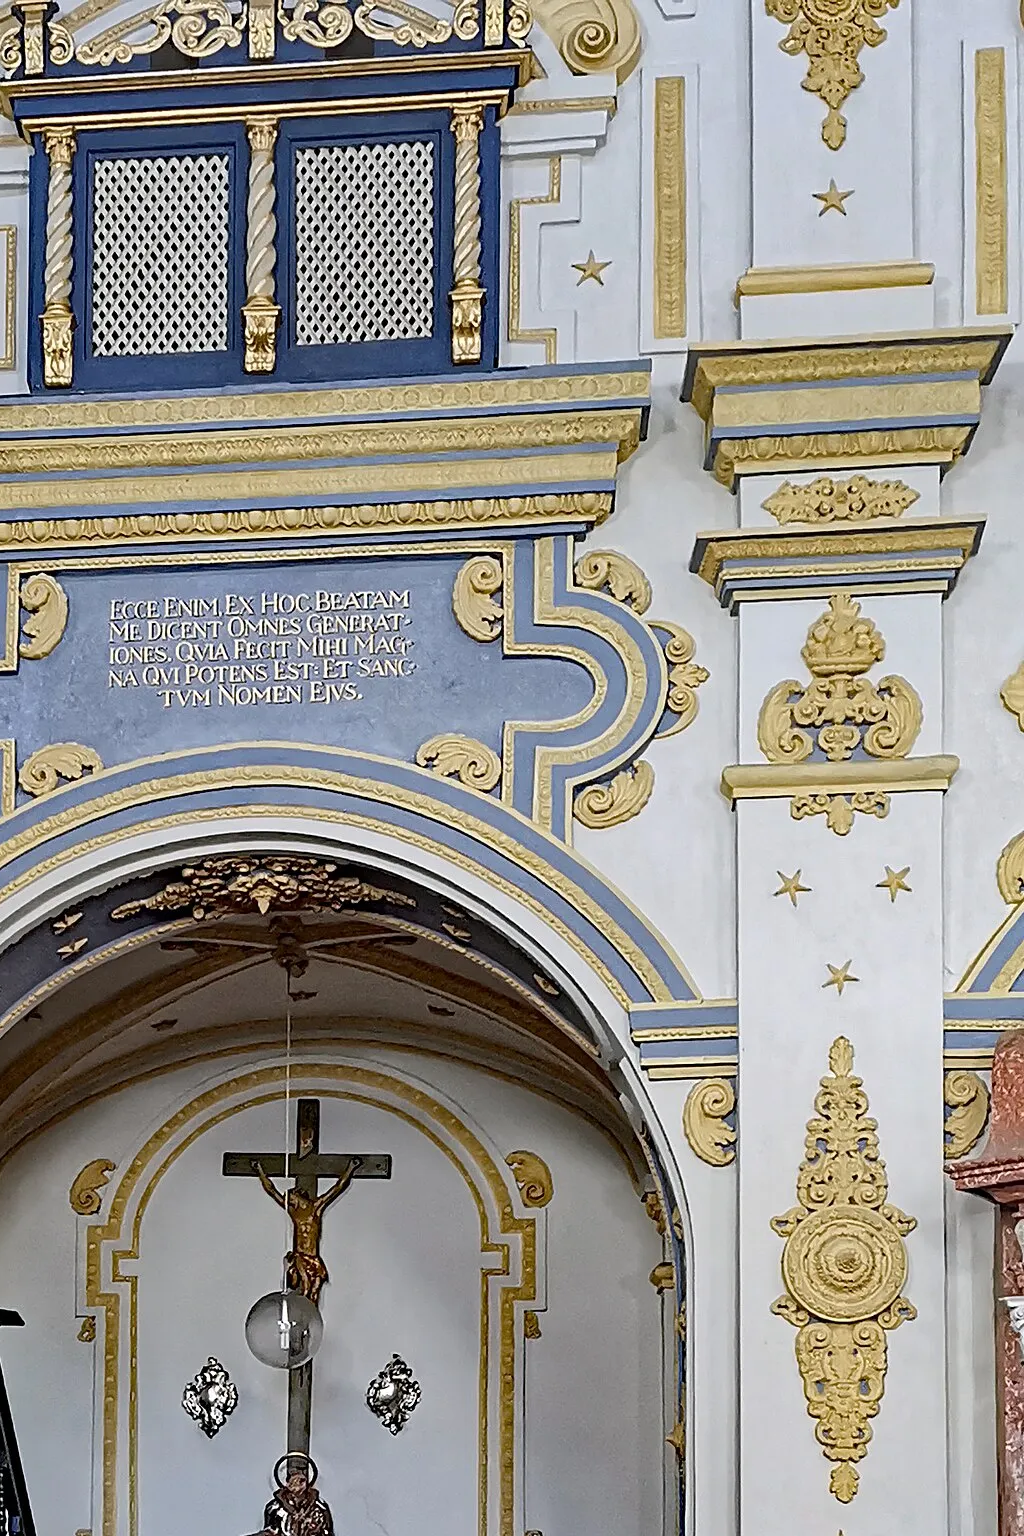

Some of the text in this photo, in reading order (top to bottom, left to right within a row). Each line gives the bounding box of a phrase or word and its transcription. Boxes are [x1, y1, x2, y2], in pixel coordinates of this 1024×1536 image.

[108, 598, 161, 621] ECCE
[224, 593, 256, 617] EX
[314, 588, 411, 612] BEATAM
[108, 621, 144, 643] ME
[147, 619, 224, 642] DICENT
[226, 614, 303, 638] OMNES
[175, 640, 231, 664] QVIA
[233, 637, 292, 660] FECIT
[296, 634, 350, 658] MIHI
[107, 668, 140, 689] NA
[142, 665, 182, 687] QVI
[185, 662, 269, 685] POTENS
[322, 657, 354, 680] ET
[156, 689, 213, 710] TVM
[216, 683, 303, 707] NOMEN
